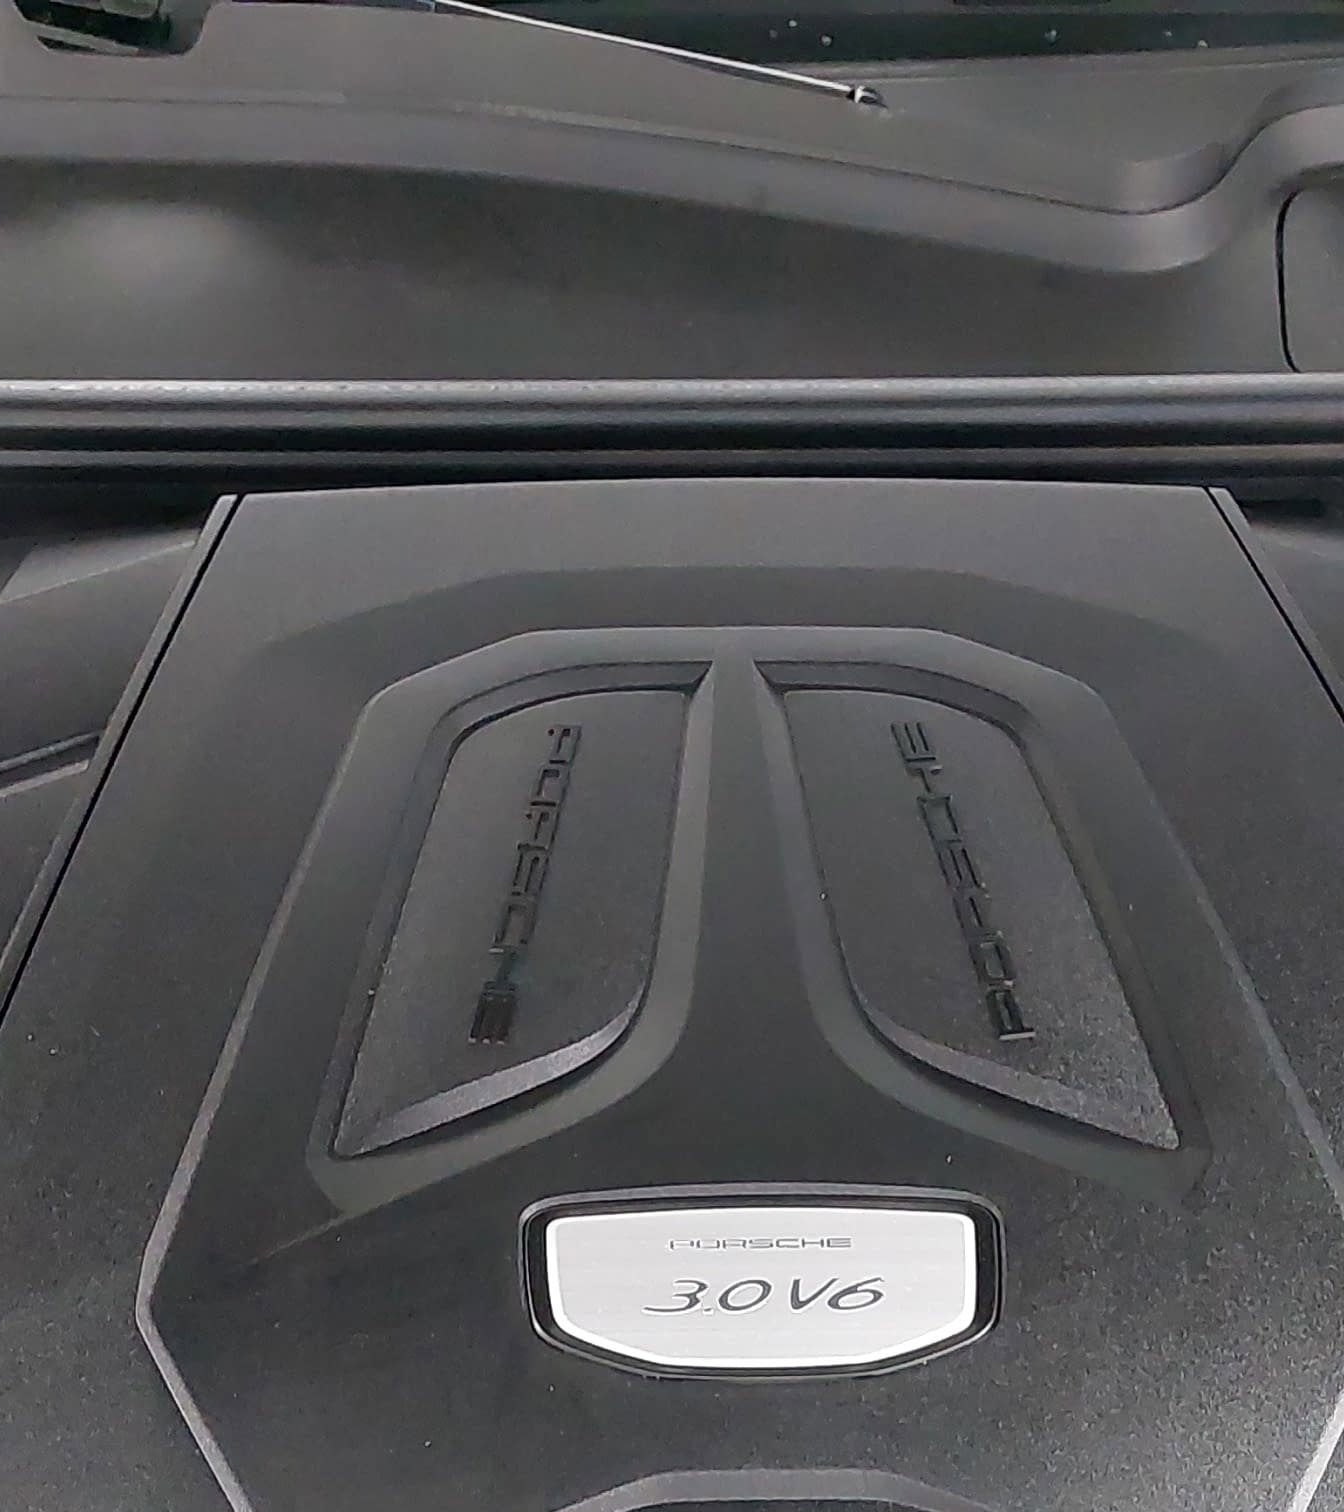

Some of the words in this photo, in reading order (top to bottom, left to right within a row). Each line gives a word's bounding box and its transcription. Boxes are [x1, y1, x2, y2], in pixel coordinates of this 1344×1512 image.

[468, 724, 582, 1044] PORSCHE
[891, 721, 1036, 1040] PORSCHE
[643, 1278, 773, 1315] 3.0
[789, 1276, 885, 1311] V6
[668, 1237, 853, 1251] PORSCHE
